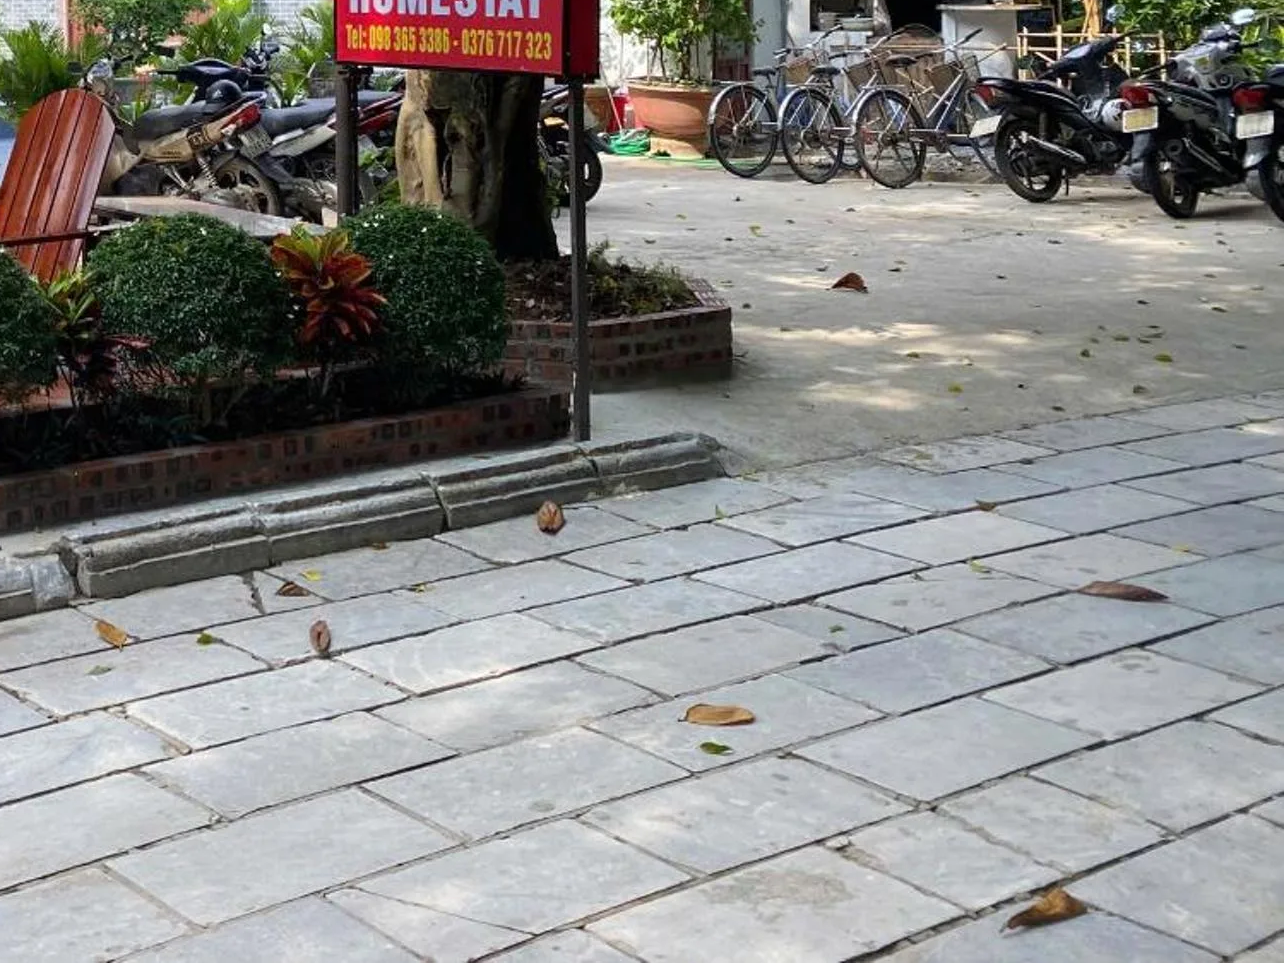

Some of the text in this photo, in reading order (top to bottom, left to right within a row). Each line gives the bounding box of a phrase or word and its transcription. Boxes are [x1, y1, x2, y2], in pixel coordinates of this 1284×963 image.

[345, 24, 367, 49] Tel:
[369, 24, 391, 51] 098
[393, 25, 416, 52] 365
[461, 28, 494, 56] 0376
[496, 29, 523, 58] 717
[525, 31, 552, 60] 323
